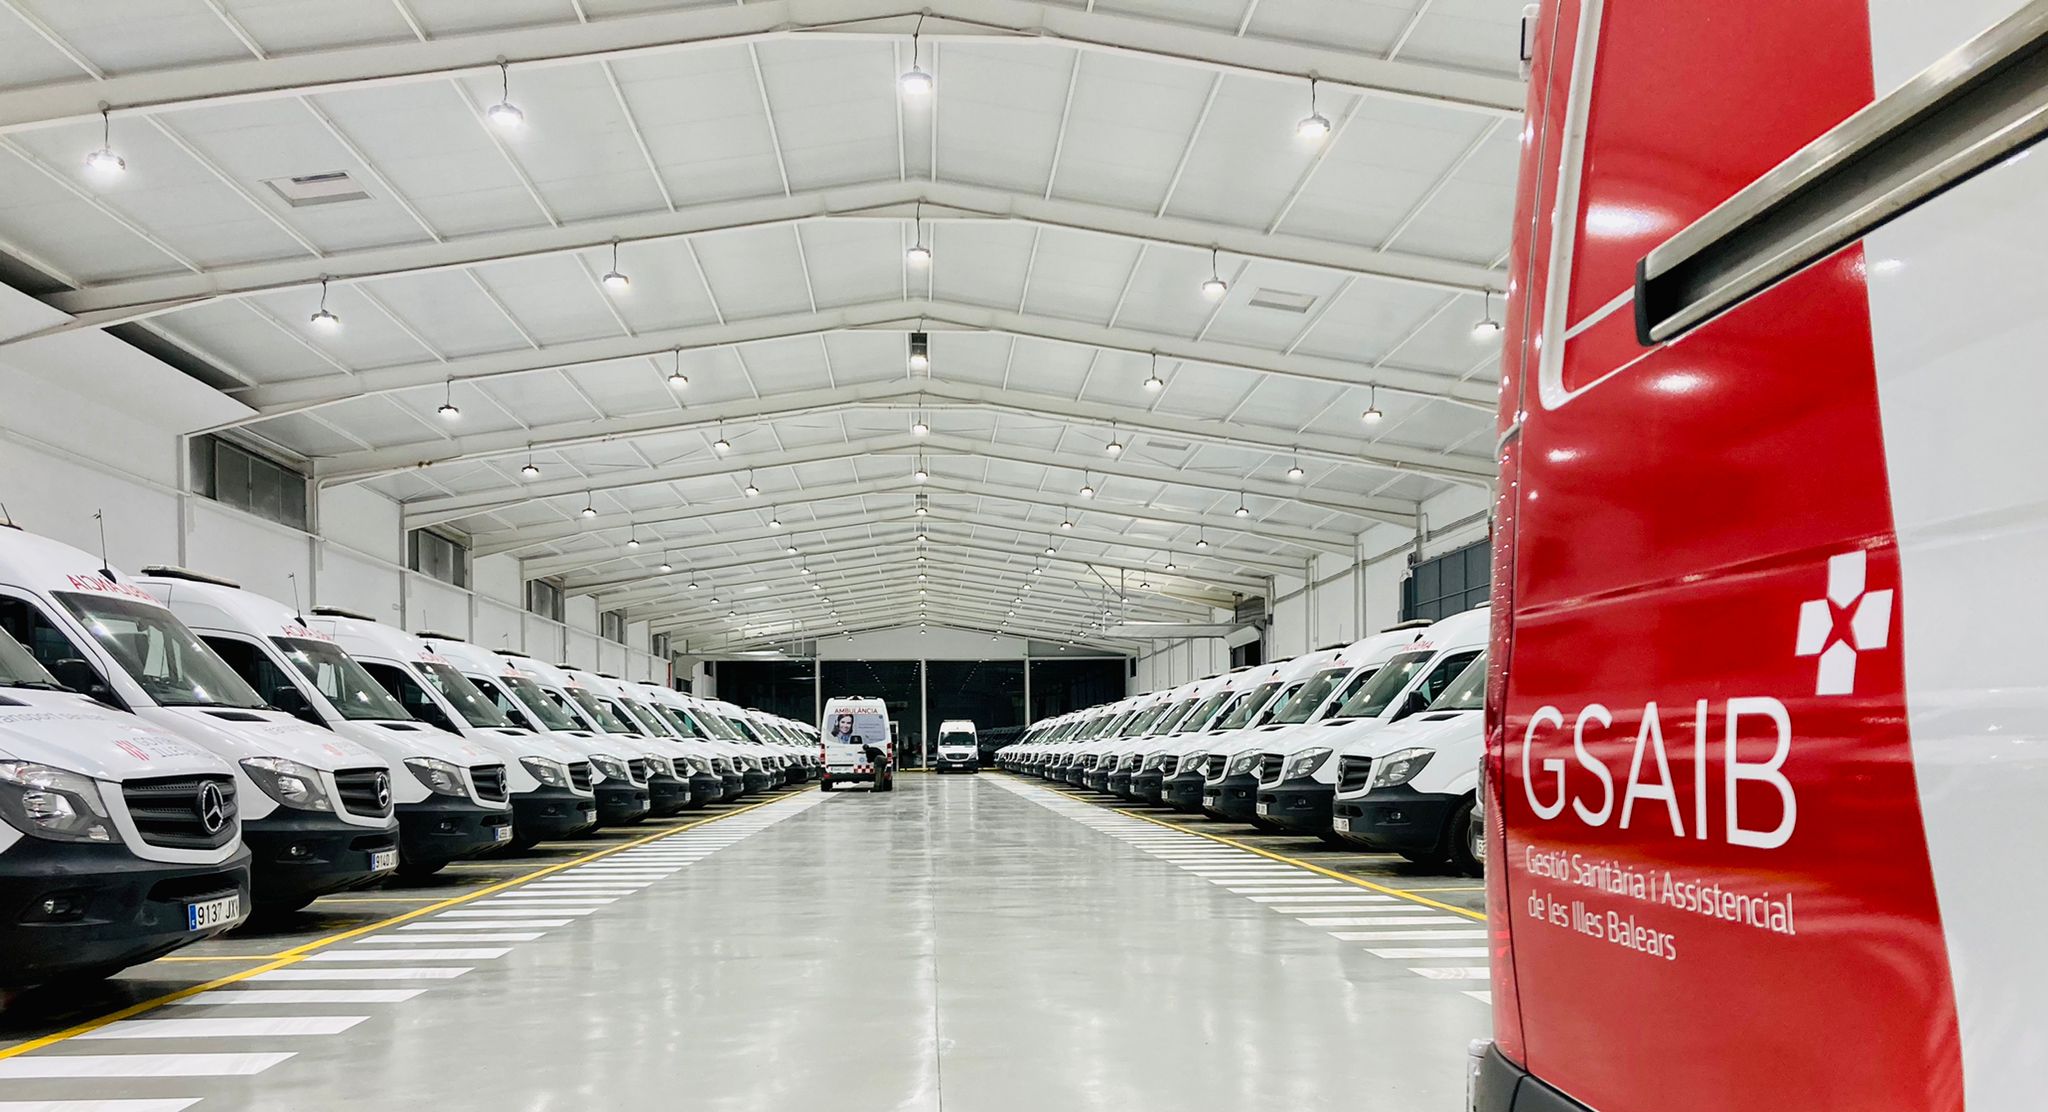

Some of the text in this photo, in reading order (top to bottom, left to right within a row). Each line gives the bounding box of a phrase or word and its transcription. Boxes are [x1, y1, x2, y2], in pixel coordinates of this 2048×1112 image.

[1522, 696, 1797, 849] GSAIB
[198, 901, 222, 925] 9137
[1526, 845, 1796, 935] Gestió Sanitària i Assistencial
[1527, 889, 1677, 961] de les Illes Balears
